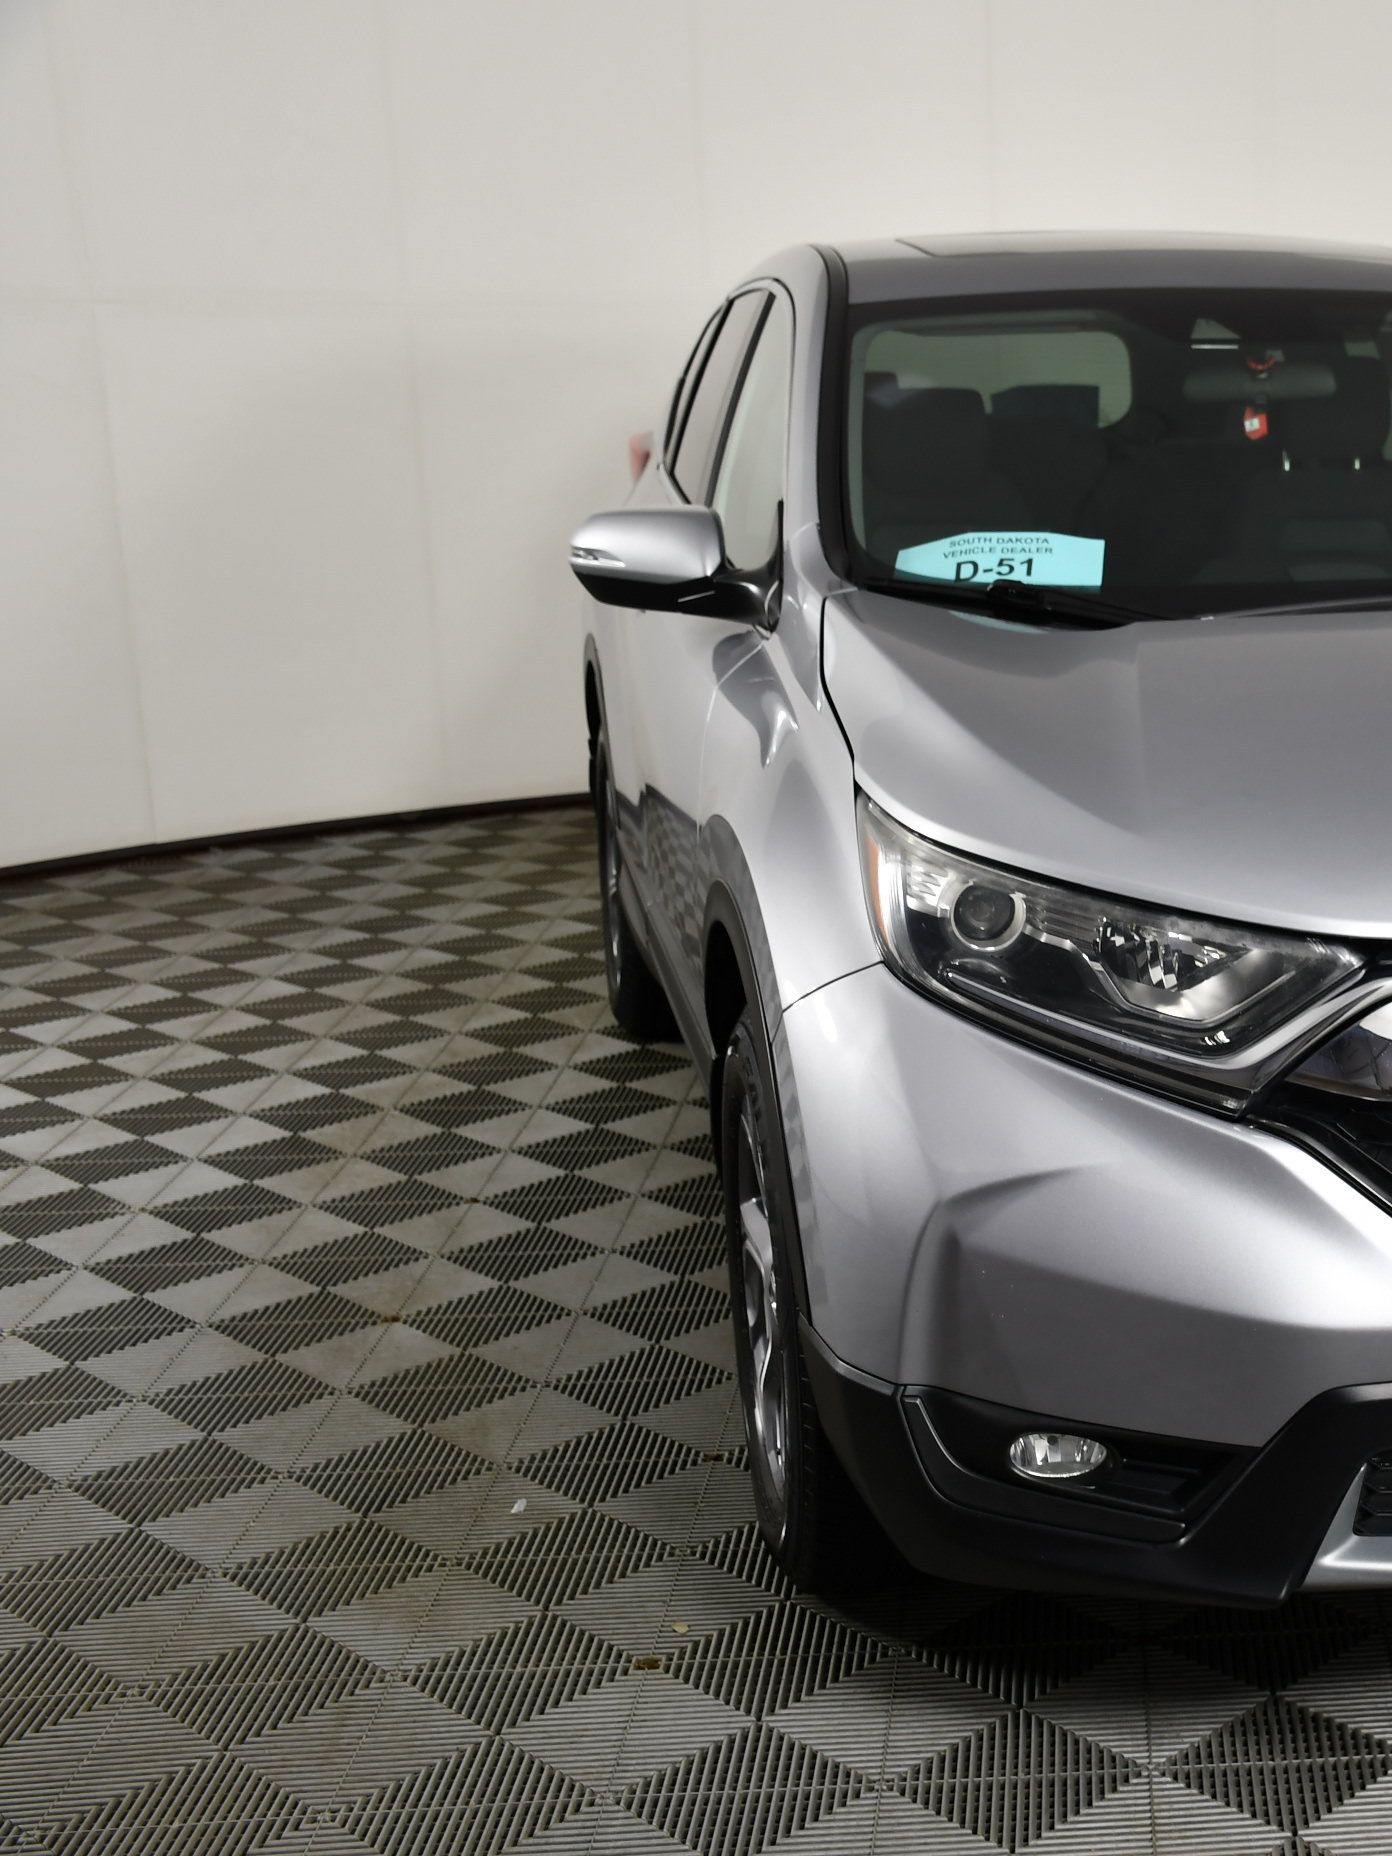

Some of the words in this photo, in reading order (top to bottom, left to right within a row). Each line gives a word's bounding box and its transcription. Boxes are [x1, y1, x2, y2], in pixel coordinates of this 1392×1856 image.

[950, 537, 993, 548] SOUTH
[996, 537, 1049, 545] DAKOTA
[943, 547, 996, 559] VEHICLE
[1001, 546, 1053, 554] DEALER
[954, 558, 1034, 583] D-51
